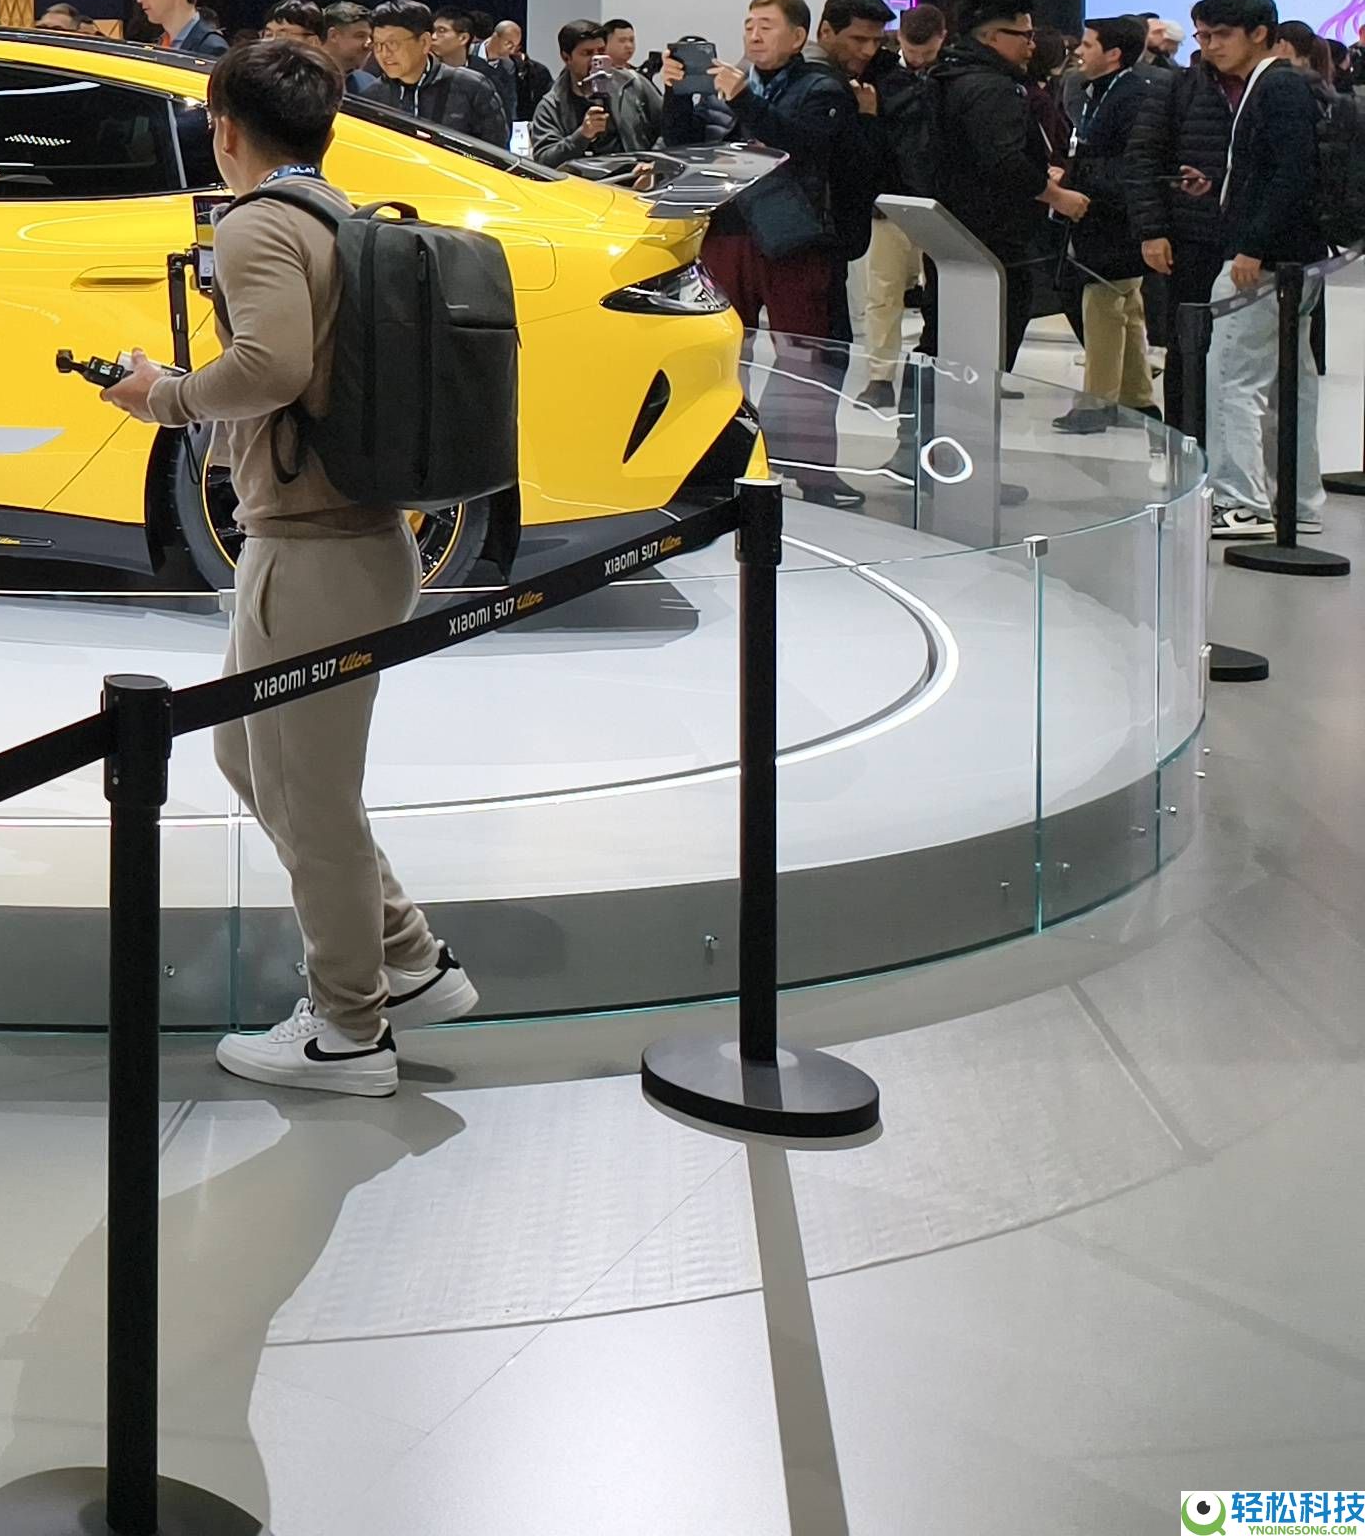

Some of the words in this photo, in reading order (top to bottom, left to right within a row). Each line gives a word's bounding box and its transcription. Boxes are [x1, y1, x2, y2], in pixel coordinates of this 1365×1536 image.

[641, 542, 659, 564] SU7
[494, 597, 516, 620] SU7
[516, 589, 544, 611] Ultra
[311, 657, 337, 683] SU7
[338, 650, 373, 674] Ultra
